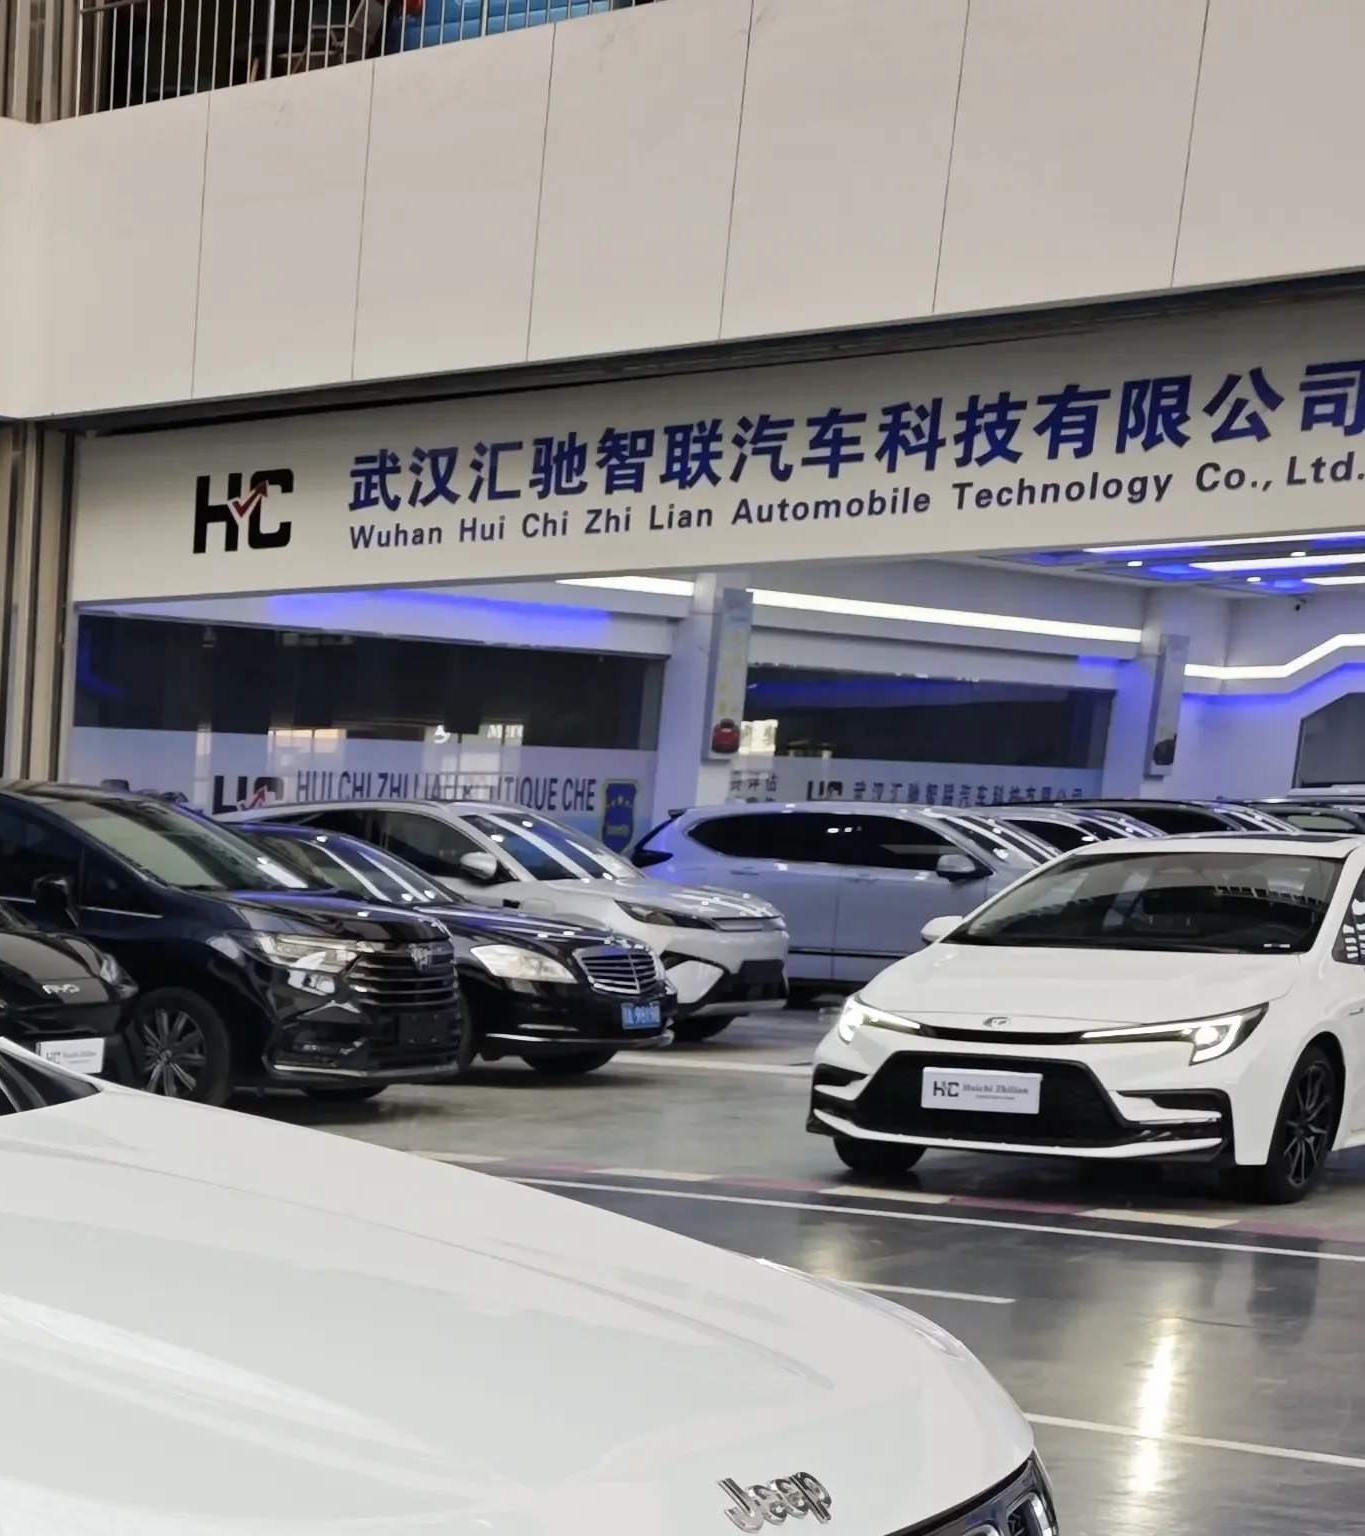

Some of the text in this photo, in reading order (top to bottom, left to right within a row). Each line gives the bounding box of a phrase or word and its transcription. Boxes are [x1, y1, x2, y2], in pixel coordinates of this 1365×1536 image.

[348, 360, 1365, 512] 武汉汇驰智联汽车科技有限公司
[193, 468, 294, 555] HC
[349, 524, 442, 550] Wuhan
[459, 515, 505, 543] Hui
[522, 510, 569, 538] Chi
[584, 506, 631, 534] Zhi
[649, 503, 713, 531] Lian
[731, 487, 931, 525] Automobile
[952, 472, 1173, 510] Technology
[565, 778, 597, 812] CHE
[717, 1471, 832, 1533] Jeep
